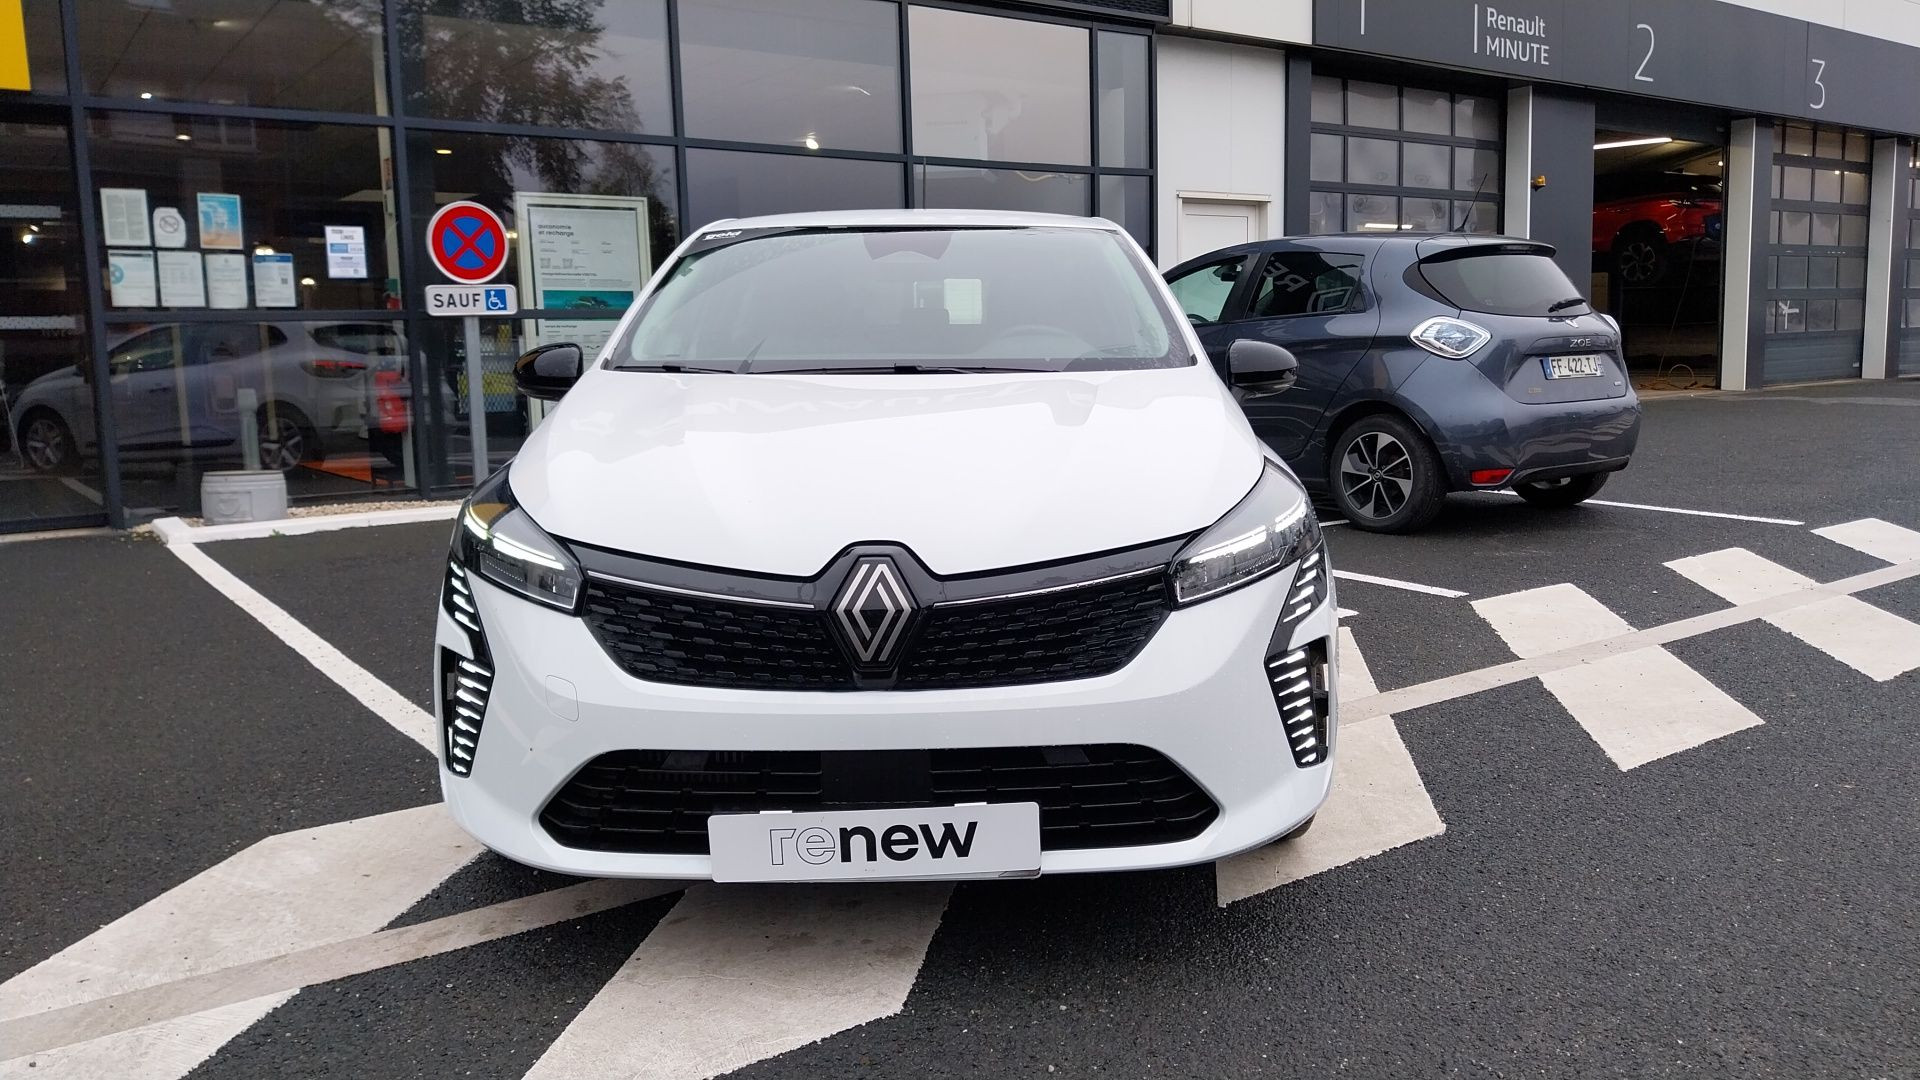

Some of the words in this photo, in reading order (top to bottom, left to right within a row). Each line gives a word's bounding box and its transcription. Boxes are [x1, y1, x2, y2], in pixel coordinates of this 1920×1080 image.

[1487, 7, 1546, 38] Renault
[1486, 35, 1550, 66] MINUTE
[1634, 24, 1655, 82] 2
[1809, 59, 1827, 109] 3
[433, 293, 481, 308] SAUF
[1569, 338, 1592, 348] ZOE
[768, 820, 979, 866] renew
